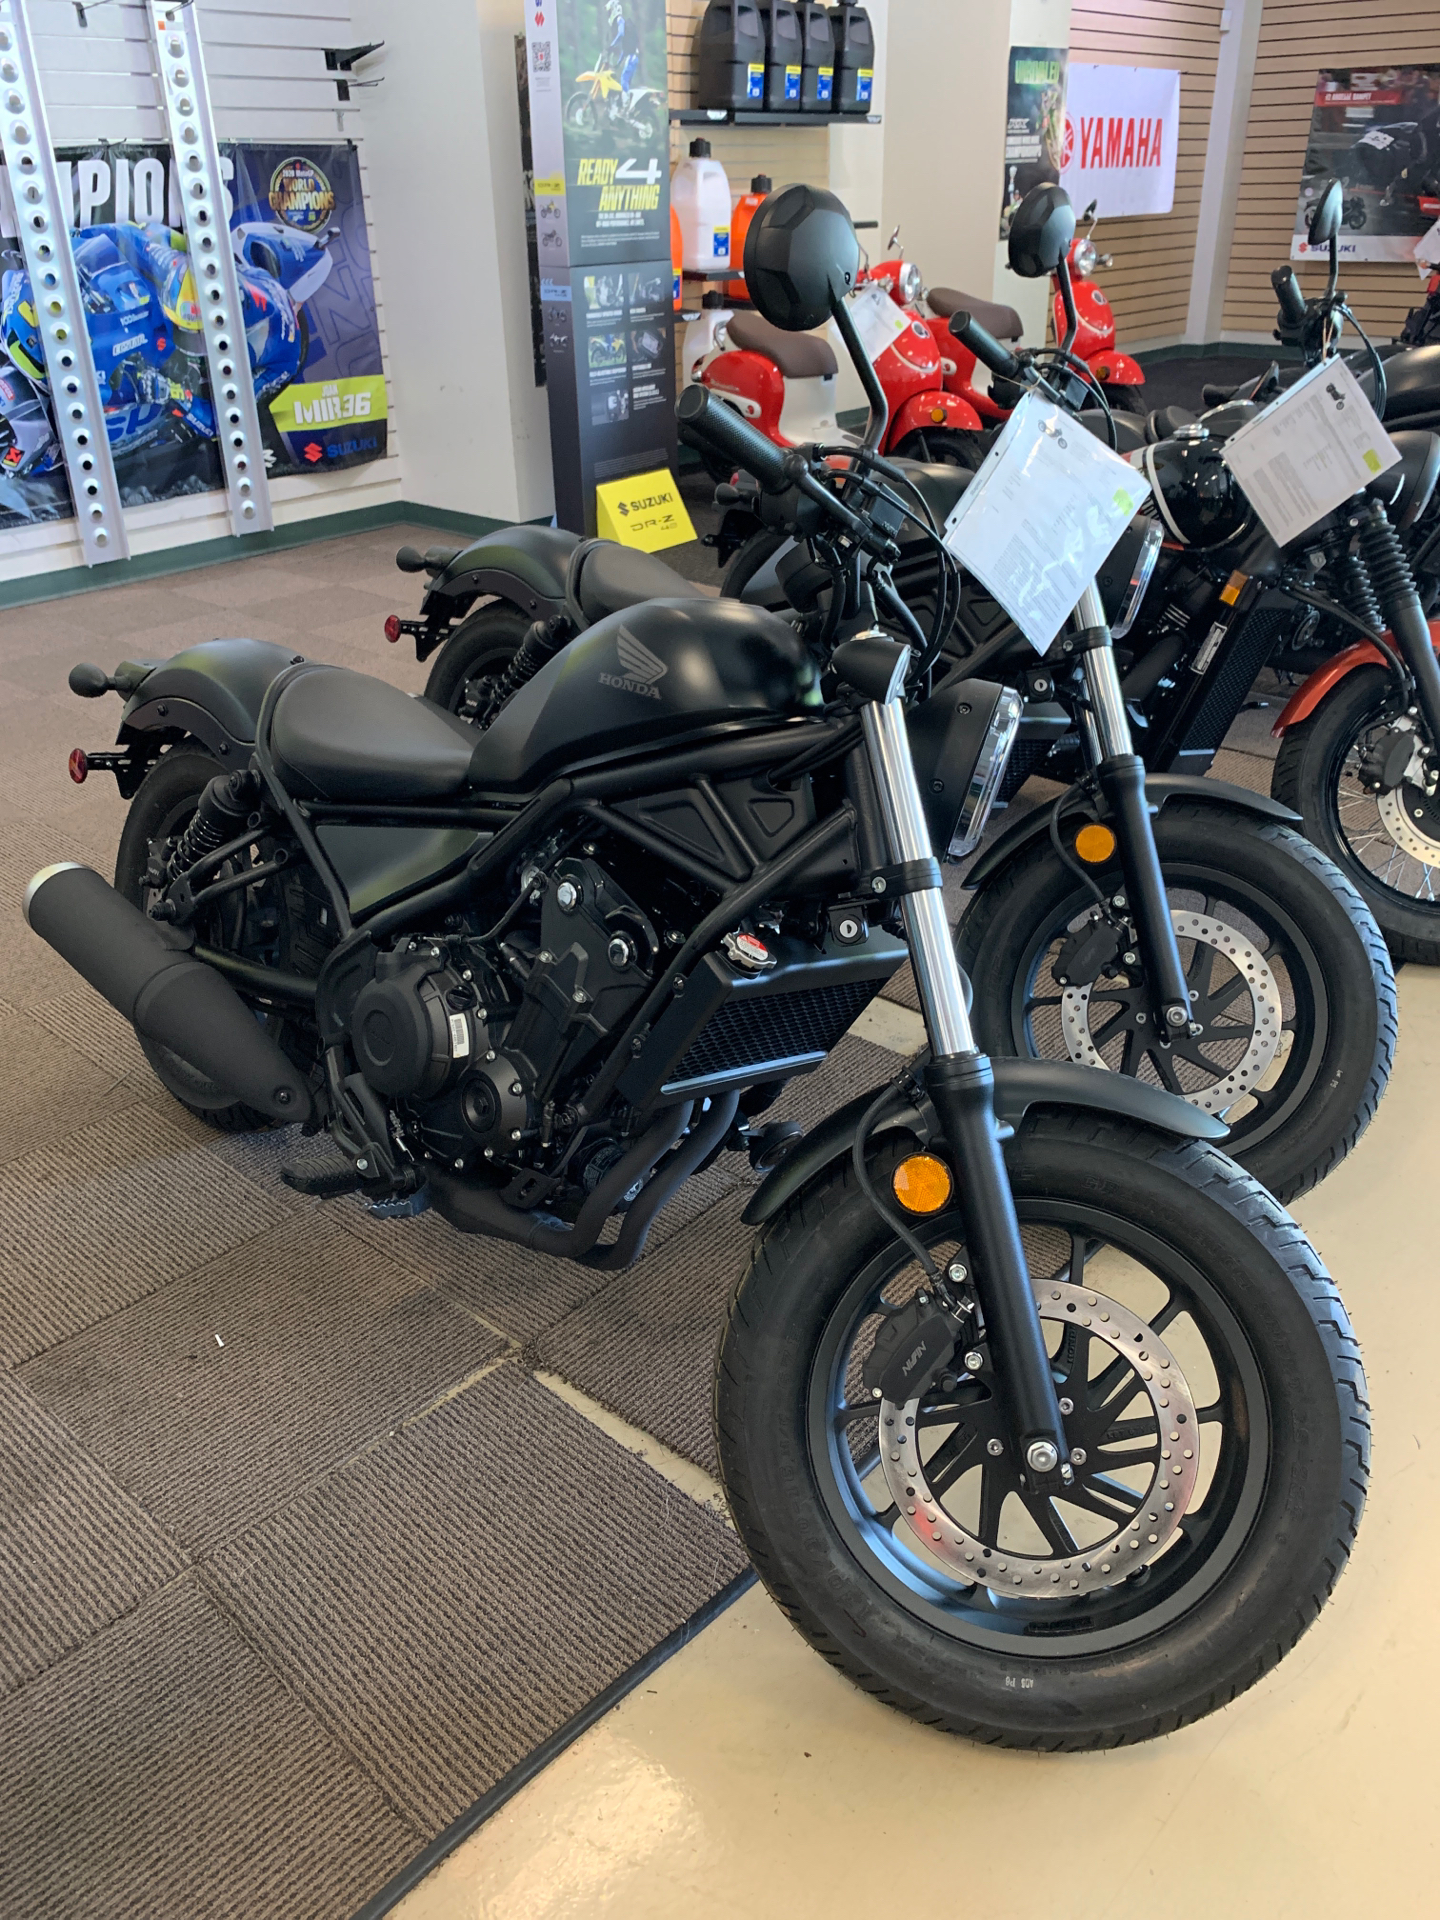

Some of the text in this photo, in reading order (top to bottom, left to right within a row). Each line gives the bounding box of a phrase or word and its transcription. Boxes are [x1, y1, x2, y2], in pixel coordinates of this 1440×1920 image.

[1080, 117, 1163, 169] YAMAHA
[577, 158, 662, 186] READY 4
[283, 178, 315, 192] WORLD
[268, 191, 336, 211] CHAMPIONS
[599, 184, 660, 211] ANYTHING
[322, 383, 338, 397] JOAN
[326, 437, 378, 458] SUZUKI
[630, 492, 673, 511] SUZUKI
[630, 514, 674, 532] DR-Z
[598, 672, 662, 700] HONDA
